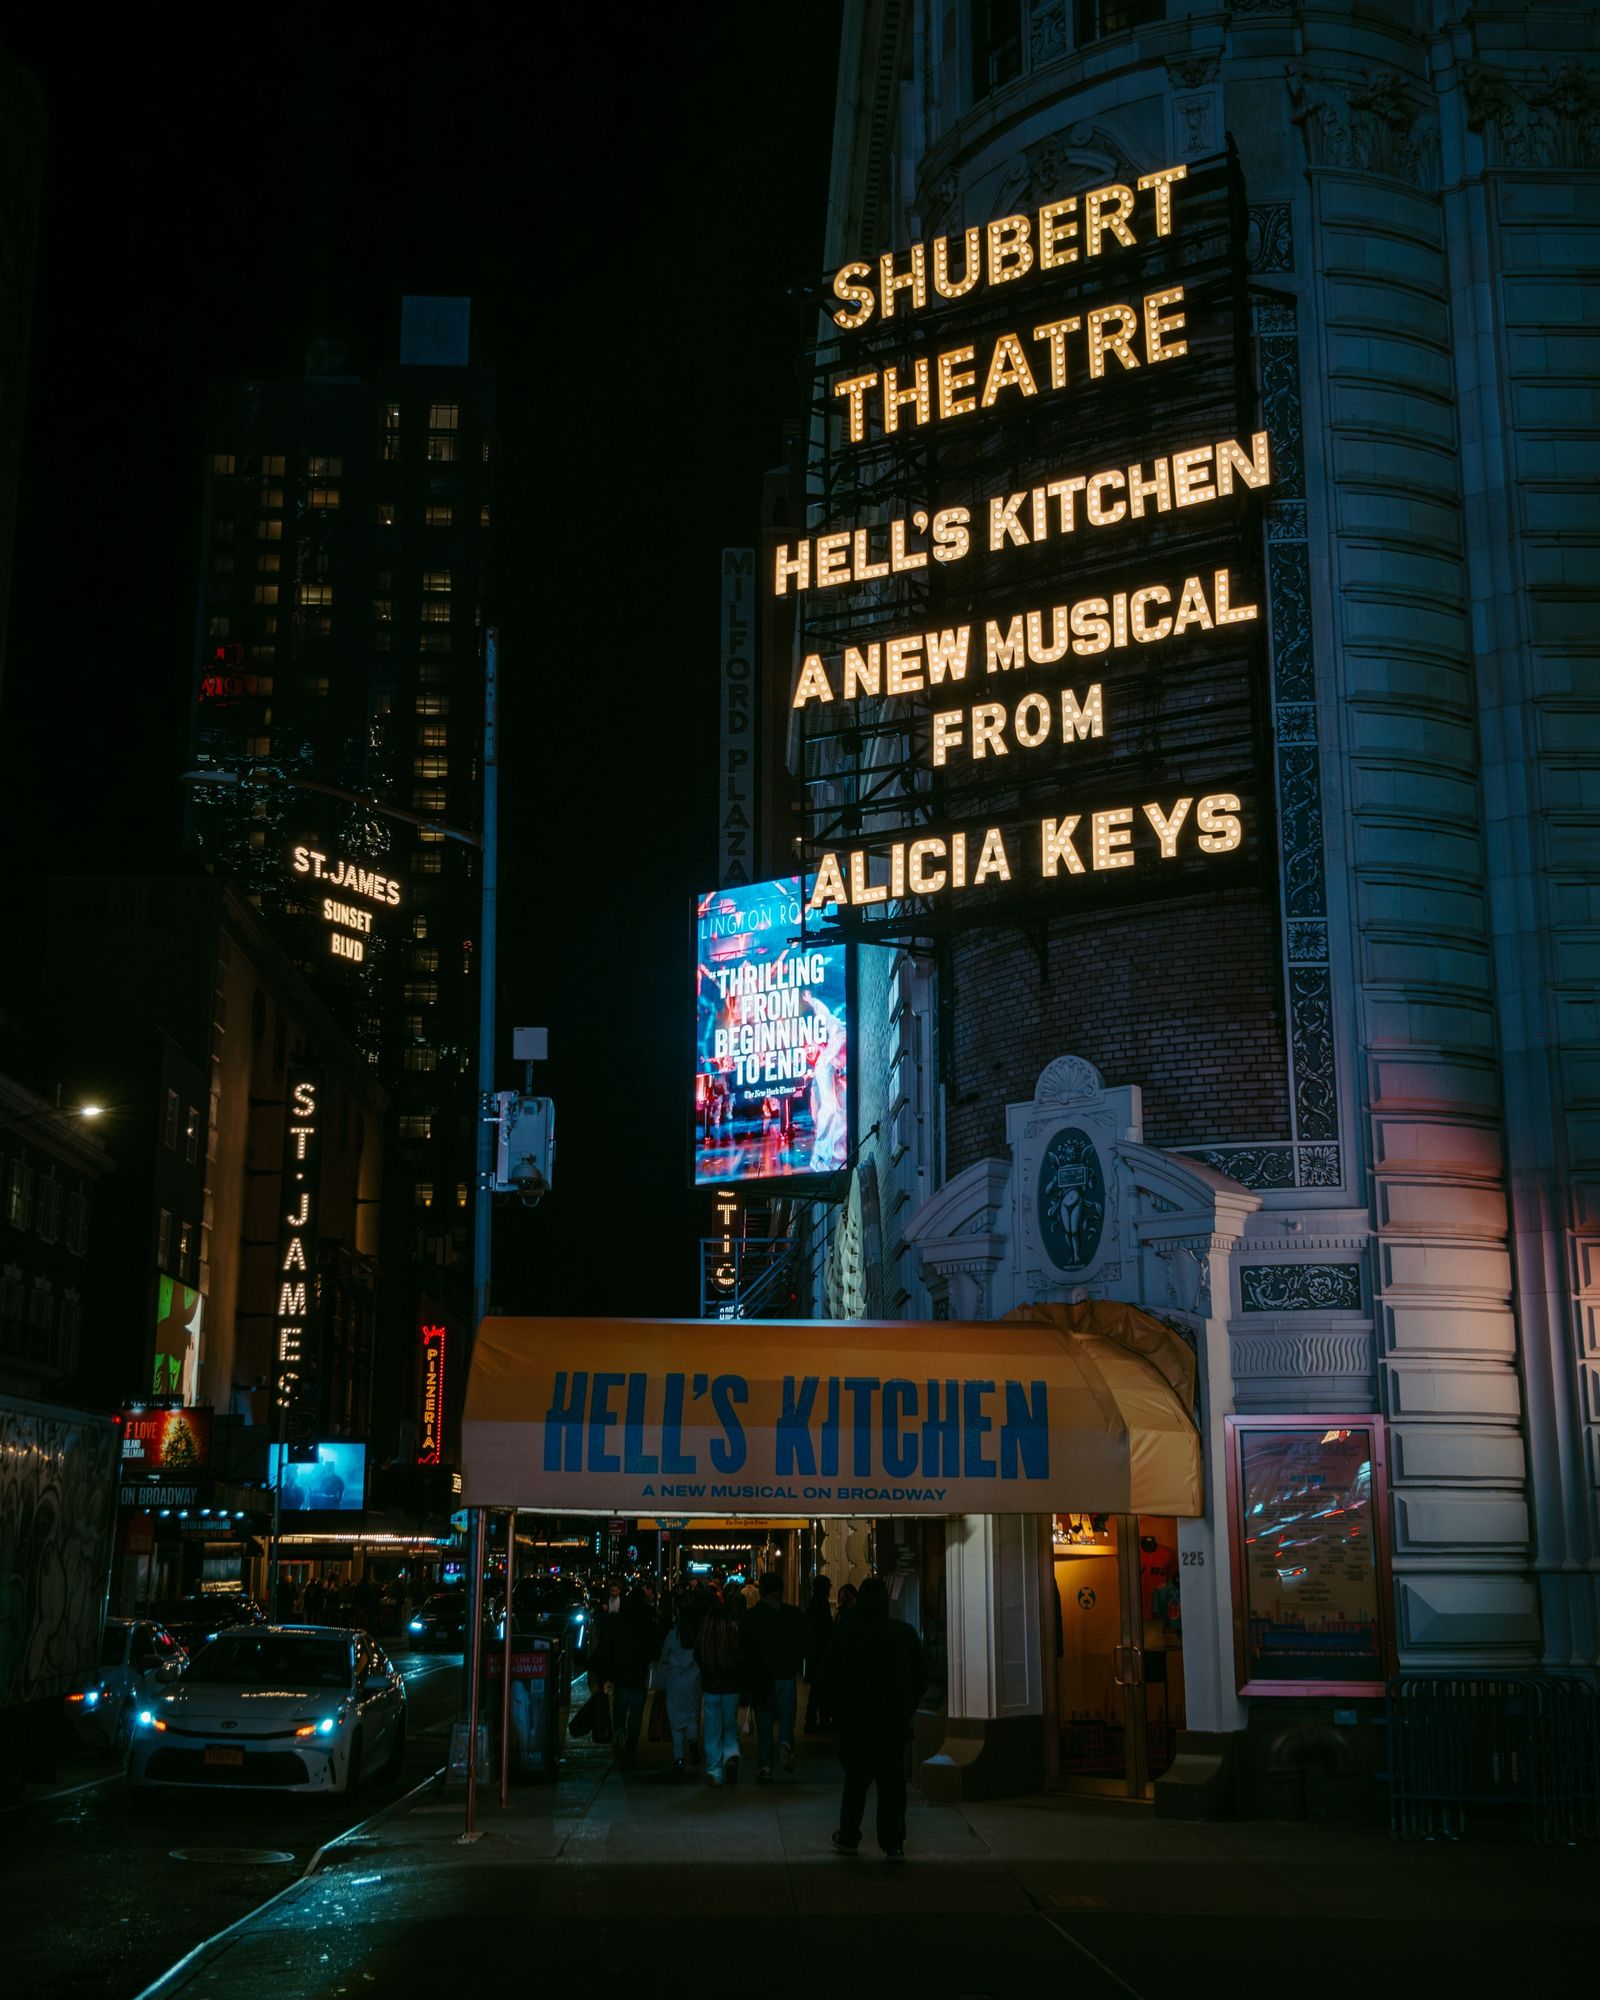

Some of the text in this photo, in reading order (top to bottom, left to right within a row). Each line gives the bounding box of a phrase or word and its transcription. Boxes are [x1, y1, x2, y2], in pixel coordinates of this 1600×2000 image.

[832, 164, 1188, 330] SHUBERT
[834, 286, 1189, 443] THEATRE
[774, 431, 1271, 596] HELL'S KITCHEN
[792, 568, 1258, 709] A NEW MUSICAL
[722, 551, 753, 886] MILFORD PLAZA
[932, 684, 1104, 767] FROM
[810, 793, 1242, 909] ALICIA KEYS
[322, 899, 373, 933] SUNSET
[331, 932, 364, 962] BLVD
[740, 987, 800, 1025] FROM
[715, 1014, 828, 1058] BEGINNING
[733, 1054, 760, 1085] TO
[744, 1085, 797, 1100] The New York Times
[422, 1348, 438, 1449] PIZZERIA
[124, 1421, 158, 1440] F LOVE
[543, 1371, 1050, 1480] HELL'S KITCHEN
[120, 1486, 197, 1505] ON BROADWAY
[641, 1484, 947, 1501] A NEW MUSICAL ON BROADWAY
[1181, 1551, 1205, 1567] 225
